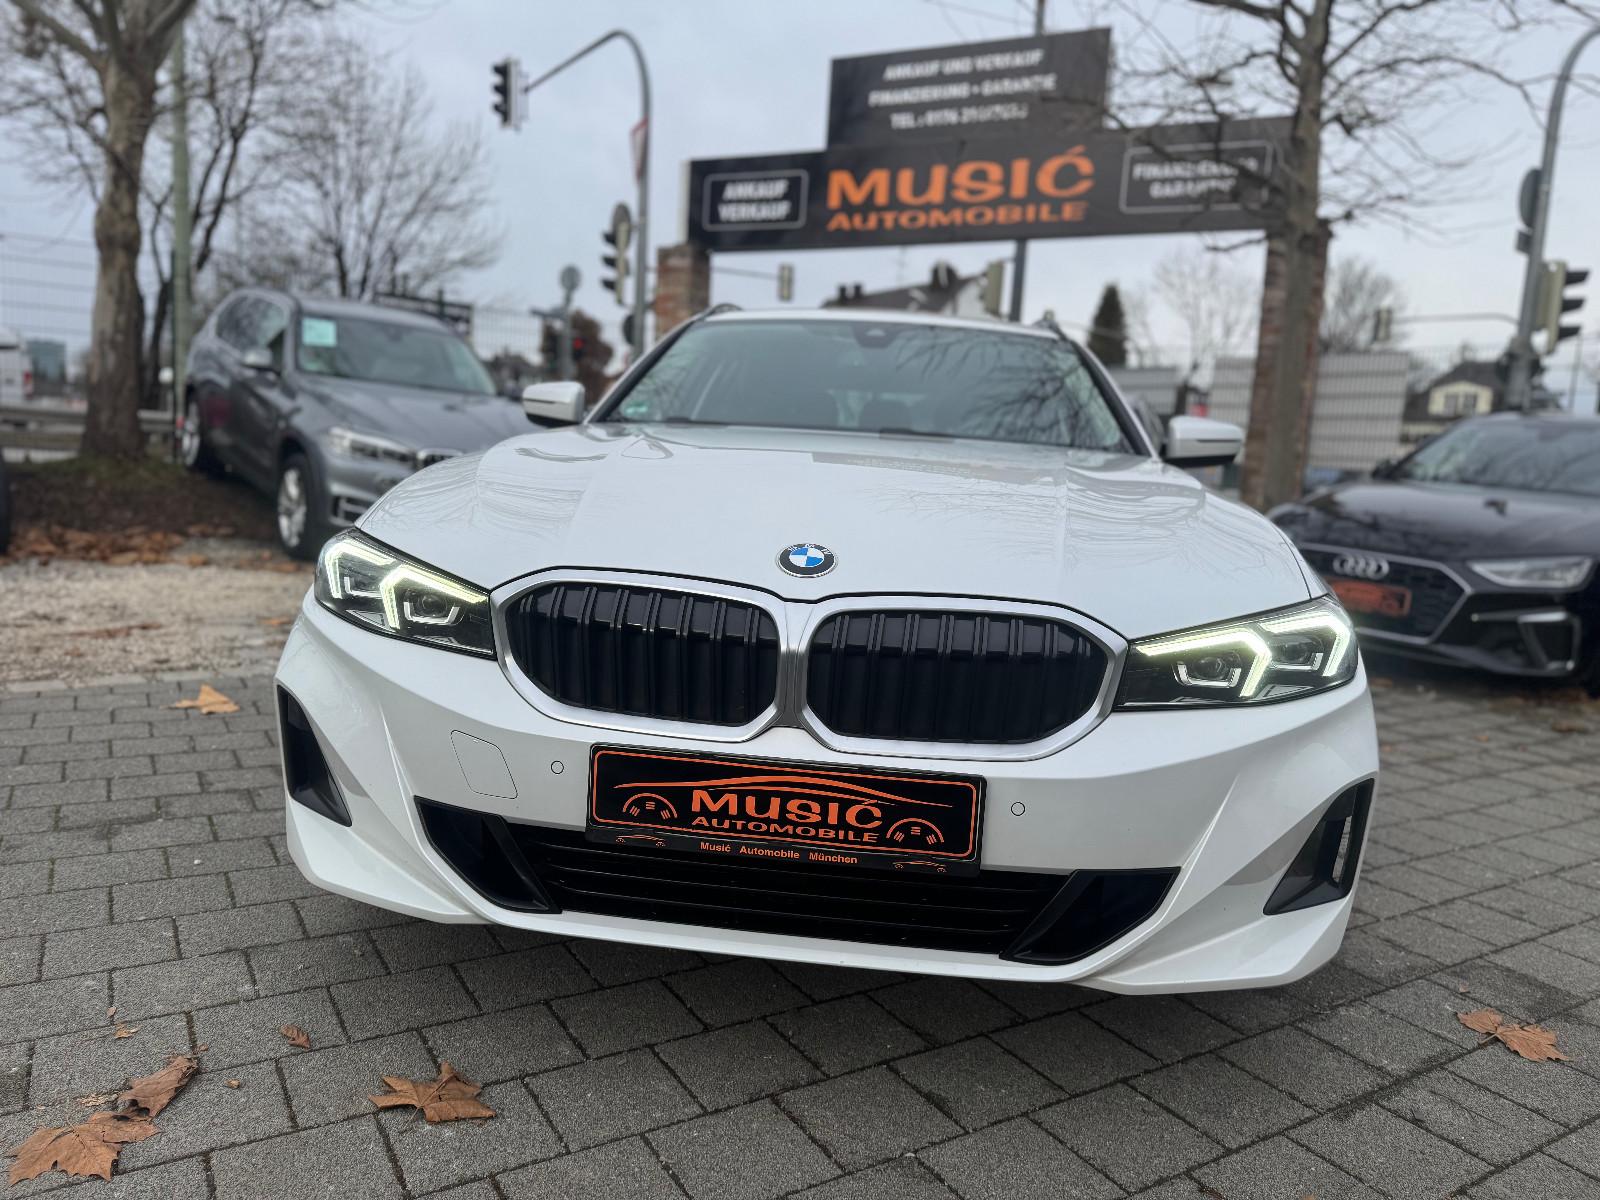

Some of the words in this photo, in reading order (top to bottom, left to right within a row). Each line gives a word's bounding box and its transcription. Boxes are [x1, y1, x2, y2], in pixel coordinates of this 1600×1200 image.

[882, 60, 941, 81] ANKAUF
[942, 56, 974, 75] UND
[974, 48, 1045, 72] VERKAUF
[722, 179, 790, 201] ANKAUF
[827, 145, 1095, 210] MUSIĆ
[717, 200, 792, 222] VERKAUF
[826, 201, 1089, 232] AUTOMOBILE
[691, 789, 882, 829] MUSIĆ
[692, 816, 880, 843] AUTOMOBILE
[700, 841, 732, 853] Musić
[739, 845, 800, 859] Automobile
[808, 852, 858, 864] München
